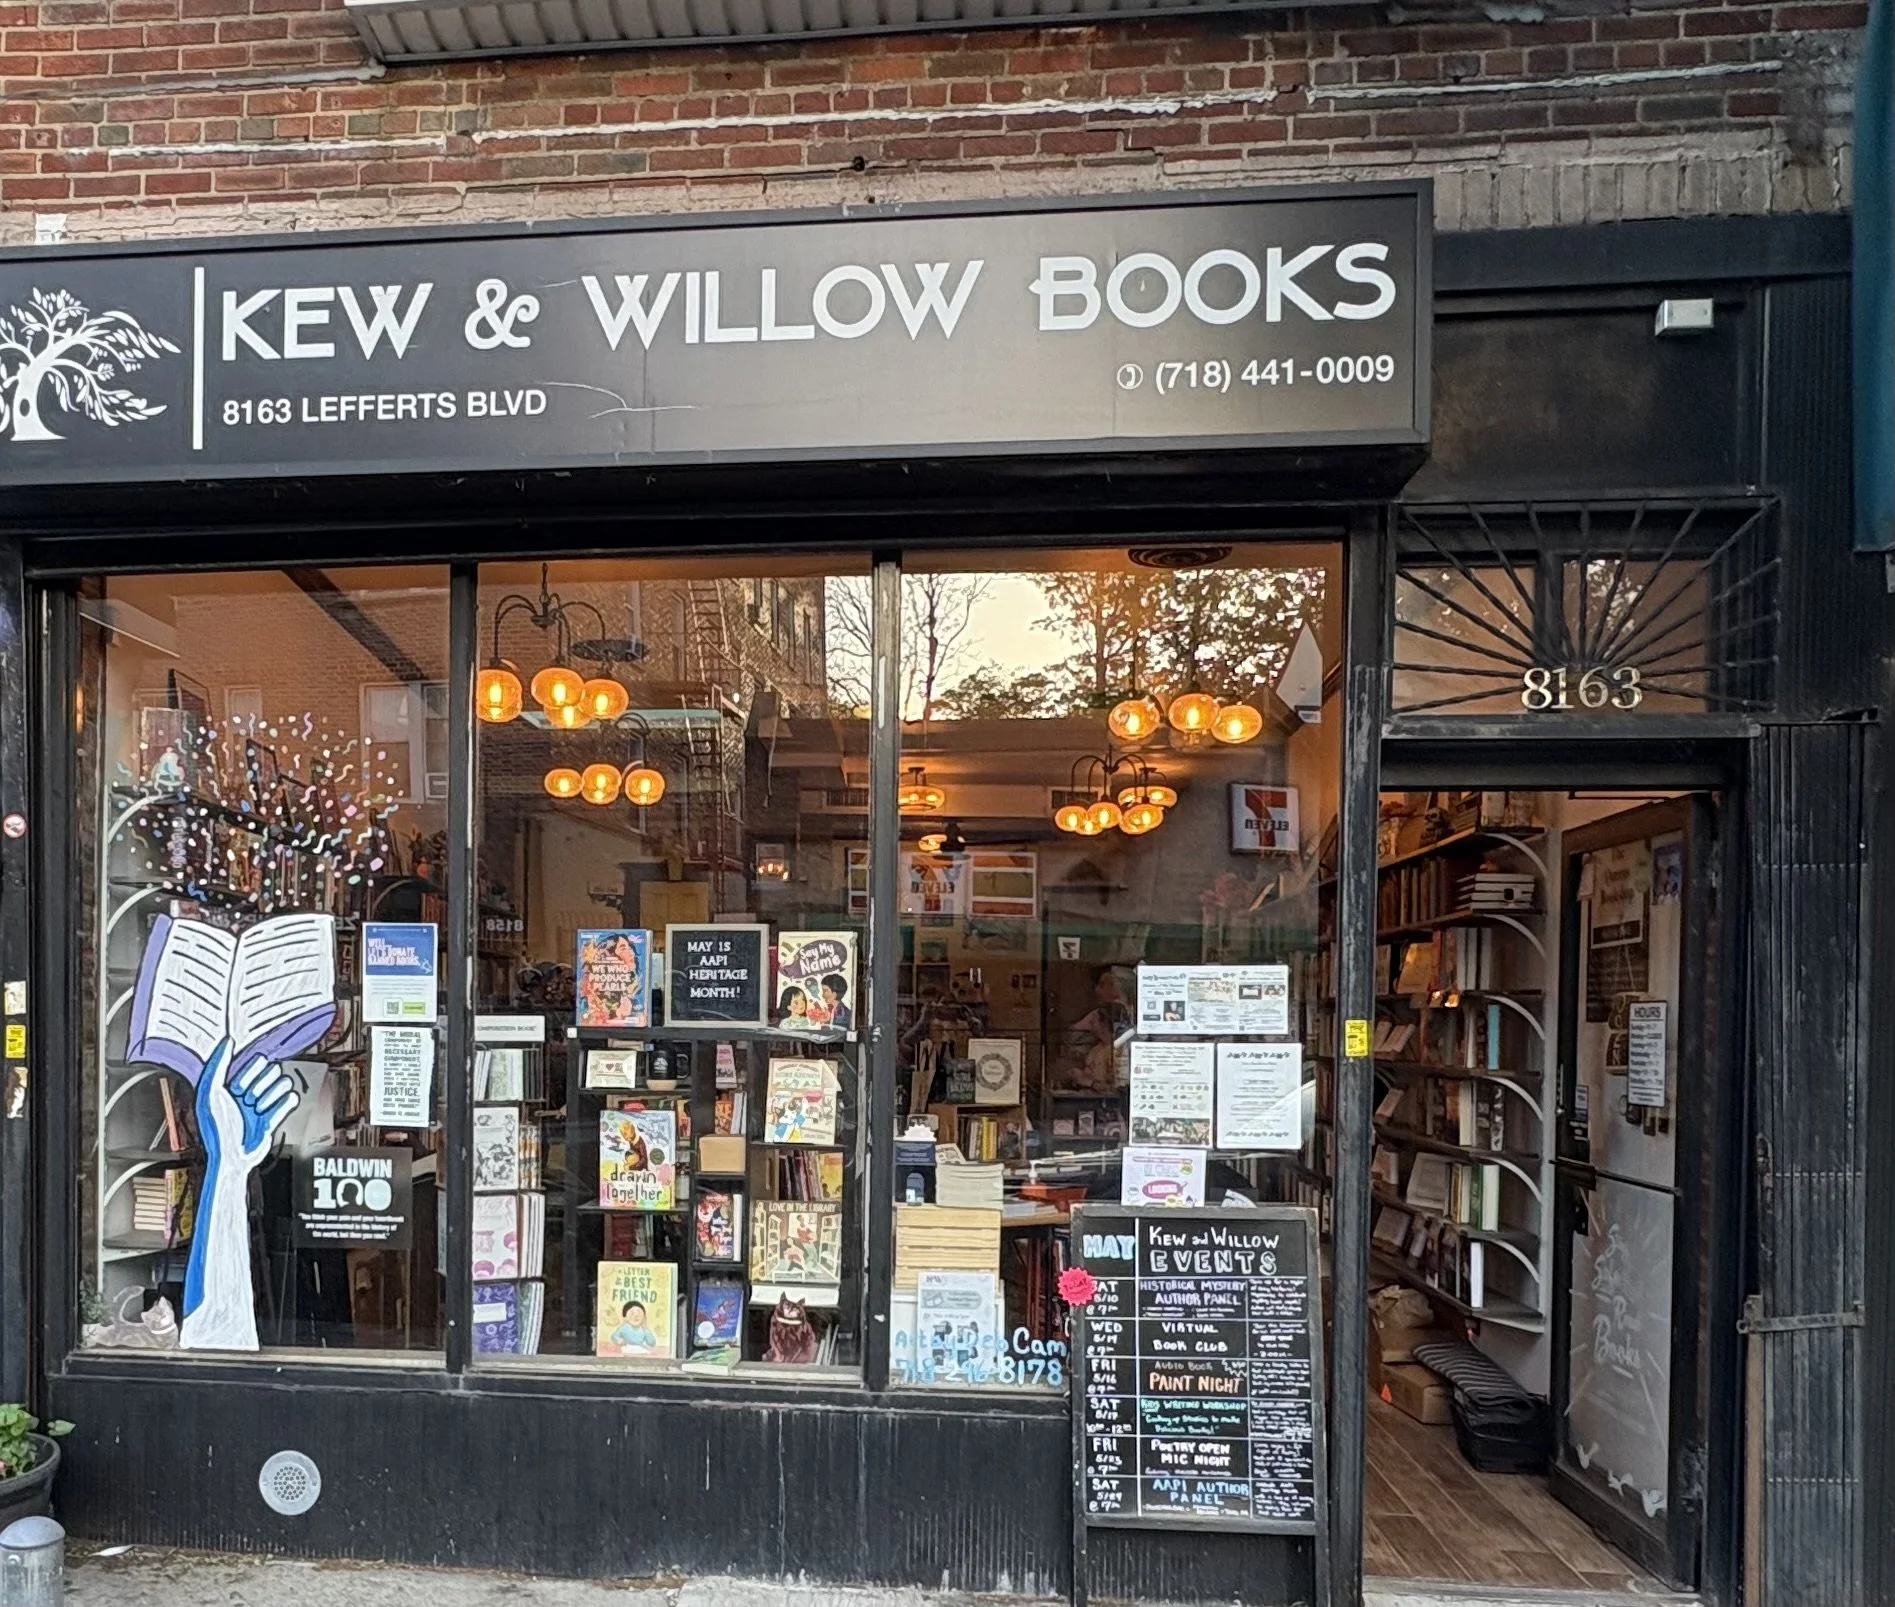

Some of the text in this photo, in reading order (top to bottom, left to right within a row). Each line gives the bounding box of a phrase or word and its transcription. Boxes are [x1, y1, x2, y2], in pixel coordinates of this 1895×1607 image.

[222, 243, 1396, 361] KEW & WILLOW BOOKS
[1155, 355, 1394, 395] (718) 441-0009
[223, 390, 547, 425] 8163 LEFFERTS BLVD
[1521, 666, 1643, 709] 8163
[687, 941, 732, 953] MAY IS
[800, 943, 835, 961] Say My
[699, 955, 728, 966] AAPI
[800, 955, 842, 976] Name
[589, 974, 632, 983] PRODUCE
[689, 969, 748, 981] HERITAGE
[690, 986, 741, 998] MONTH!
[1634, 1007, 1661, 1018] HOURS
[313, 1157, 392, 1178] BALDWIN
[610, 1163, 657, 1184] drawn
[313, 1178, 392, 1211] 100
[607, 1182, 663, 1204] together
[768, 1203, 837, 1213] LOVE IN THE LIBRARY
[1210, 1227, 1280, 1249] WILLOW
[1083, 1234, 1136, 1260] MAY
[1150, 1250, 1278, 1276] EVENTS
[623, 1277, 653, 1289] BEST
[1140, 1280, 1247, 1292] HISTORICAL MYSTERY
[611, 1289, 658, 1304] FRIEND
[1154, 1292, 1242, 1306] AUTHOR PANEL
[1090, 1320, 1124, 1333] WED
[1161, 1321, 1220, 1334] VIRTUAL
[1012, 1326, 1068, 1357] Cam
[1195, 1341, 1229, 1353] CLUB
[1091, 1358, 1117, 1372] FRI
[1093, 1373, 1118, 1385] 5/16
[1149, 1371, 1195, 1392] PAINT
[1198, 1375, 1245, 1394] NIGHT
[1090, 1397, 1122, 1411] SAT
[1092, 1436, 1118, 1453] FRI
[1150, 1438, 1231, 1455] POETRY OPEN
[1160, 1453, 1232, 1467] MIC NIGHT
[1092, 1477, 1120, 1492] SAT
[1152, 1478, 1250, 1497] AAPI AUTHOR
[1169, 1491, 1225, 1506] PANEL
